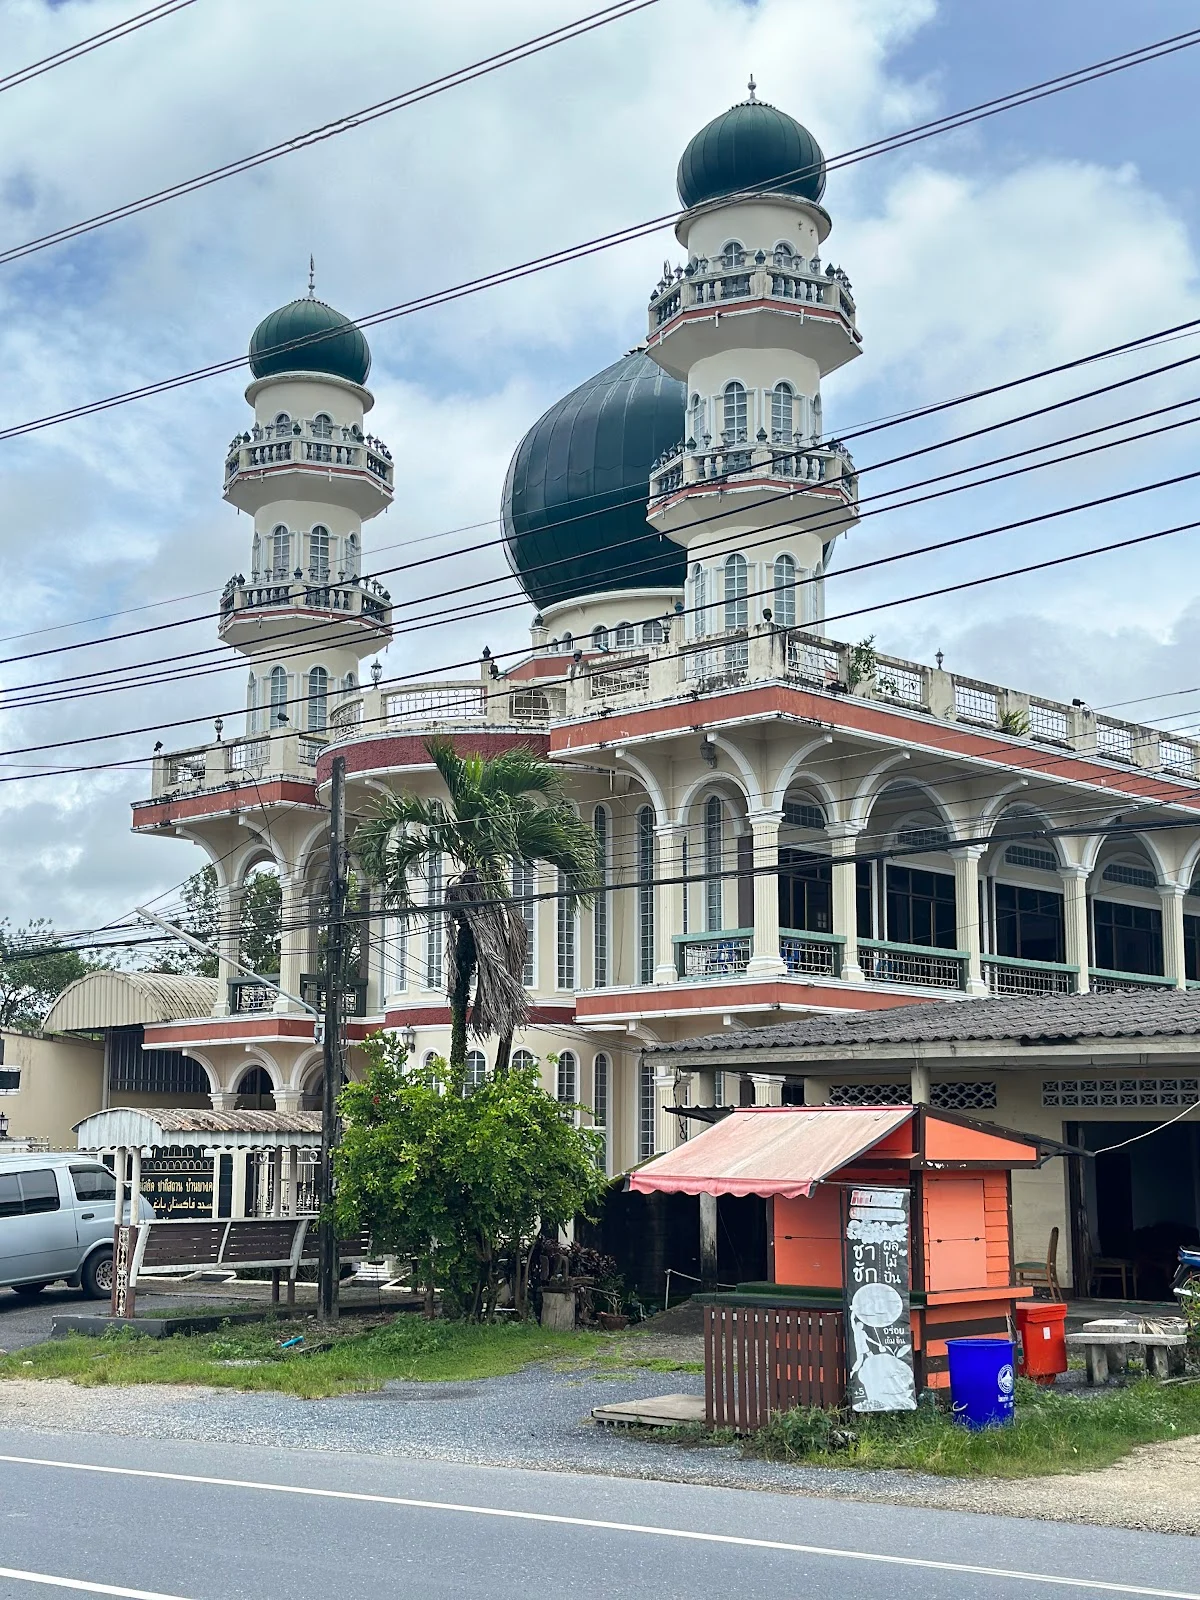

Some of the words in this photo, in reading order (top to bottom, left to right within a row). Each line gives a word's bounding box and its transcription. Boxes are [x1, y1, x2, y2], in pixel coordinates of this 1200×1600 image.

[197, 1202, 213, 1212] سجد
[853, 1245, 875, 1260] ชา
[883, 1242, 899, 1251] ผล
[883, 1251, 897, 1267] ไม้
[853, 1261, 877, 1282] ชัก
